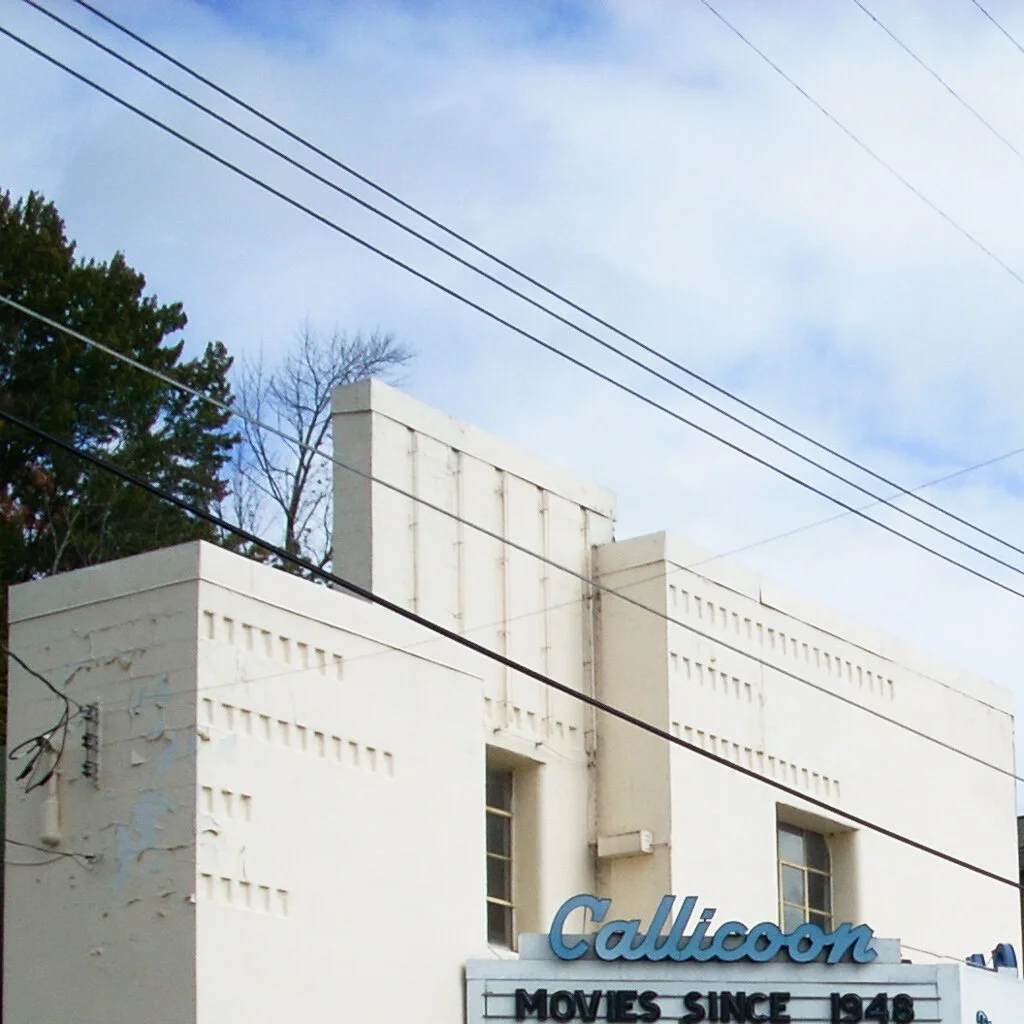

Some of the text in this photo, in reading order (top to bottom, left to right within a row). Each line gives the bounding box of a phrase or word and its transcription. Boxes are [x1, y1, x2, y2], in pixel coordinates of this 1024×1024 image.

[549, 893, 879, 964] Callicoon
[514, 988, 662, 1024] MOVIES
[682, 991, 792, 1024] SINCE
